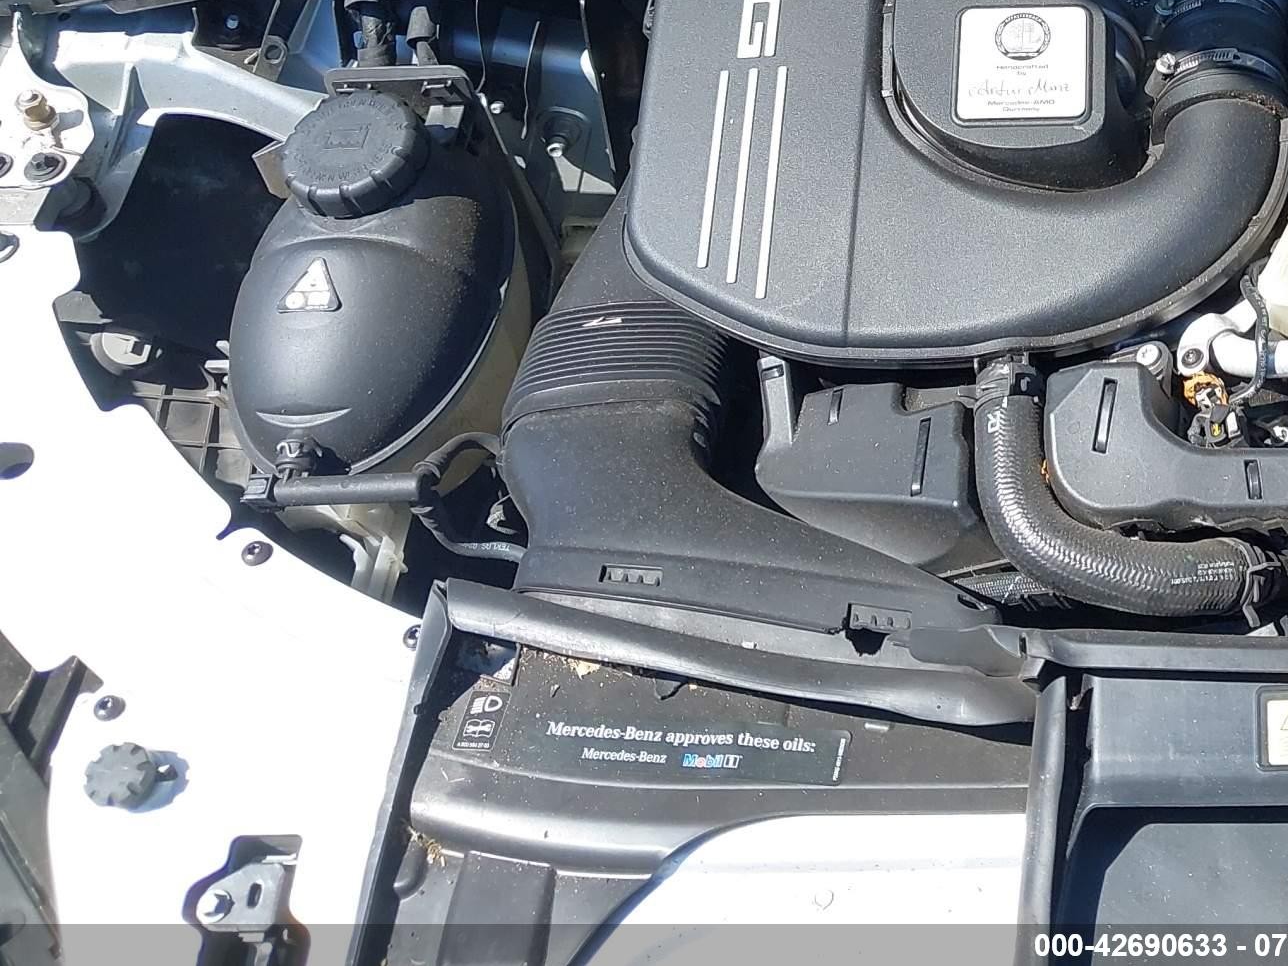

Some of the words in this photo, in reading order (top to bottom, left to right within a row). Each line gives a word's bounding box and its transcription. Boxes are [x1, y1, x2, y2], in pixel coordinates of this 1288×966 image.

[546, 720, 662, 743] Mercedes-Benz
[665, 731, 734, 748] approves
[738, 732, 779, 748] these
[782, 736, 817, 752] oils:
[581, 747, 667, 765] Mercedes-Benz
[682, 753, 723, 768] Mobil
